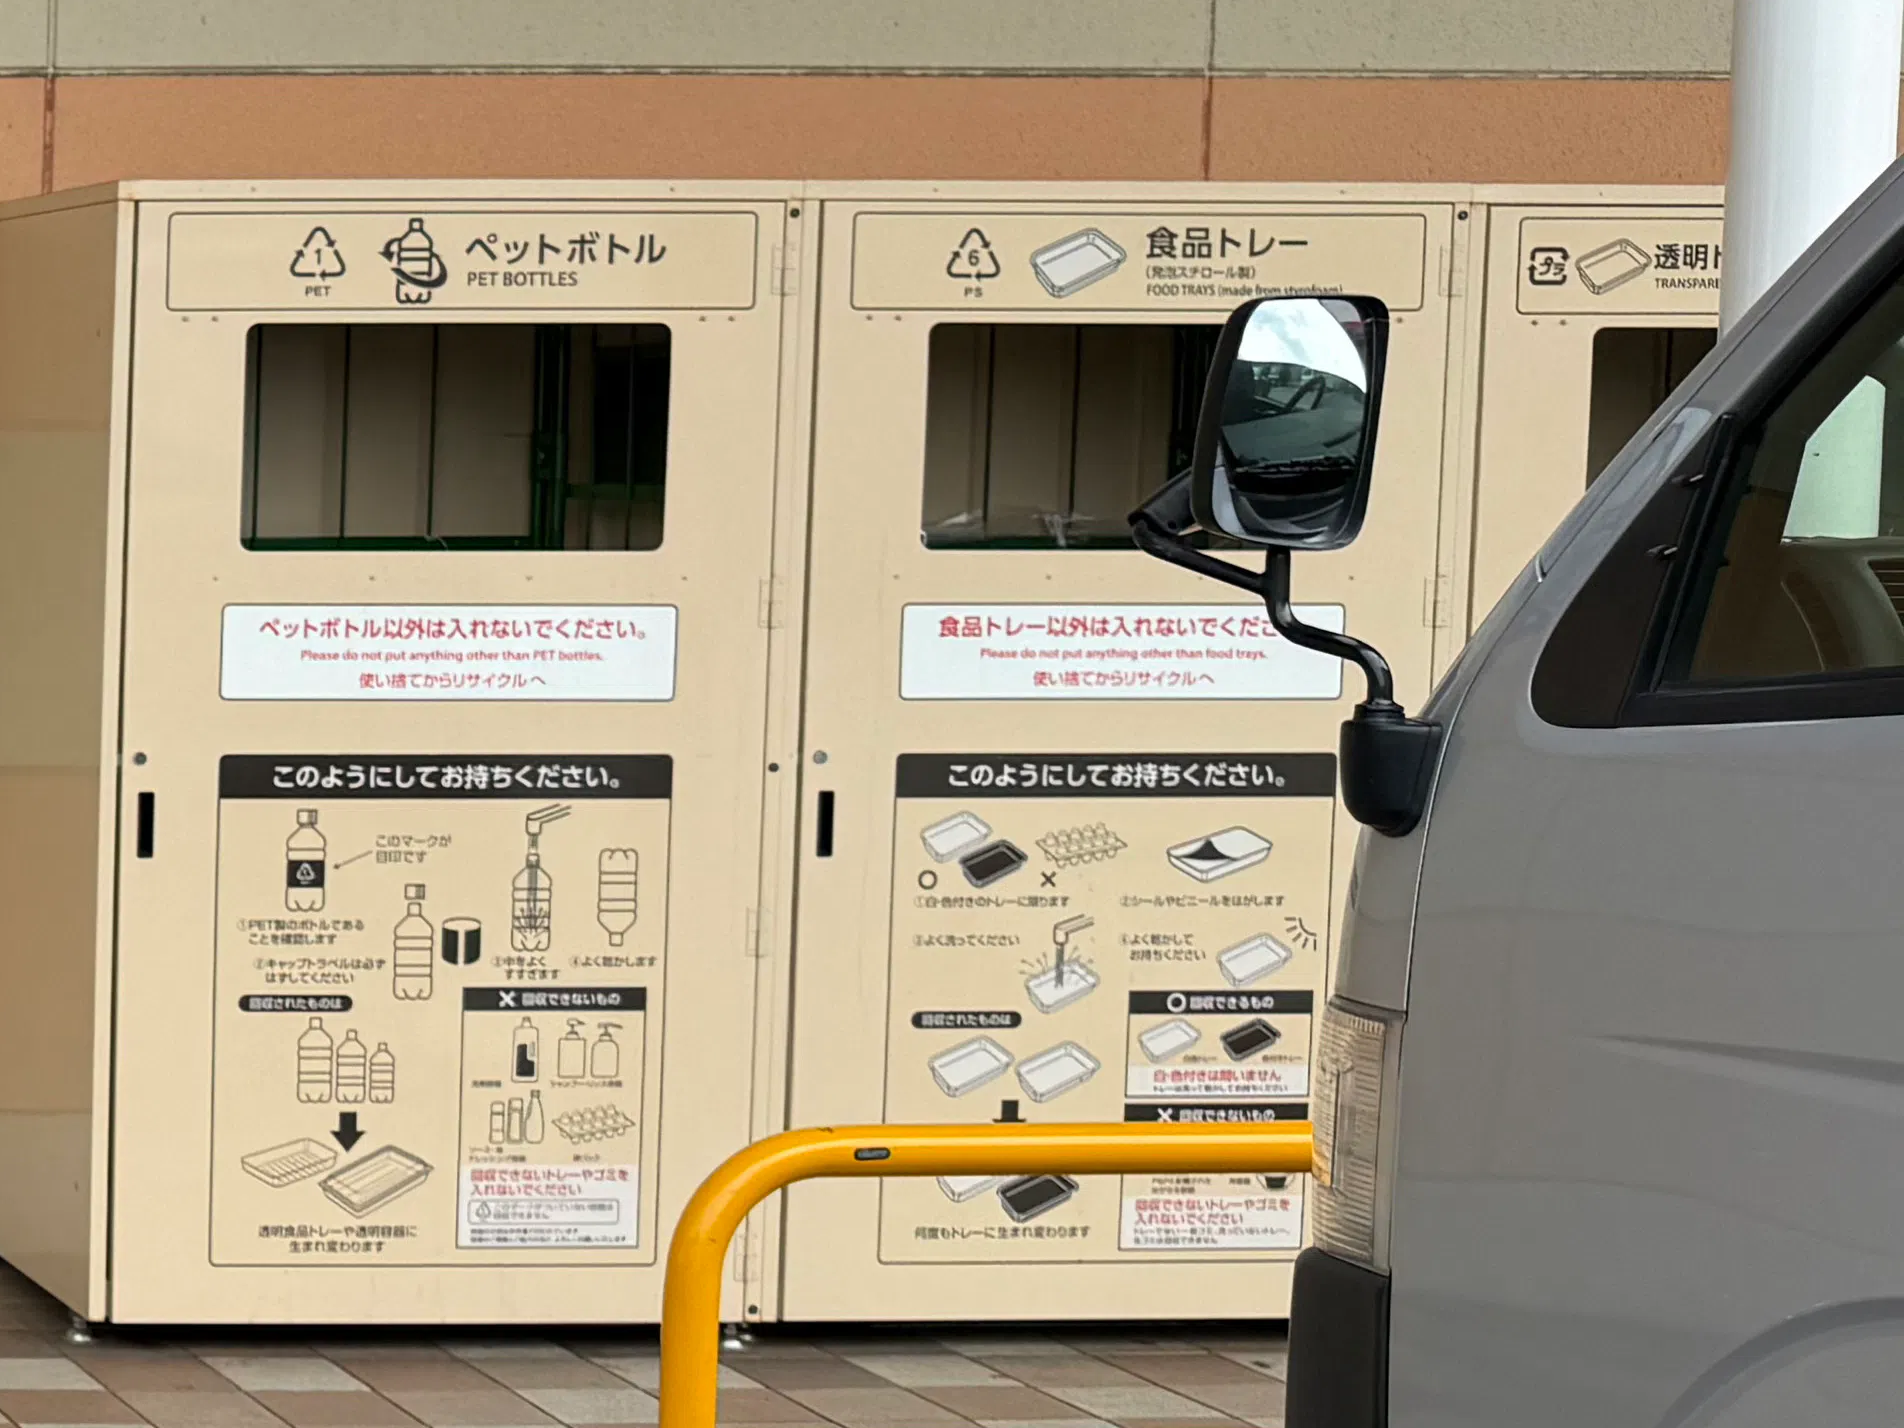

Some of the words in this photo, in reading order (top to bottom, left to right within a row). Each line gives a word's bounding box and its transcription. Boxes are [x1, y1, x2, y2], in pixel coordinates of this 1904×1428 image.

[464, 231, 667, 265] ペットボトル
[1145, 226, 1309, 260] 食品トレー
[968, 248, 980, 267] 6
[467, 272, 499, 288] PET
[503, 271, 578, 287] BOTTLES
[1655, 277, 1719, 289] TRANSPAR
[304, 285, 332, 297] PET
[964, 286, 983, 298] PS
[1146, 284, 1180, 297] FOOD
[1181, 283, 1216, 296] TRAYS
[259, 617, 646, 640] ペットボトル以外は入れないでください。
[301, 649, 339, 661] Please
[343, 648, 358, 661] do
[361, 650, 382, 661] not
[385, 650, 406, 663] put
[409, 649, 464, 663] anything
[466, 650, 498, 661] other
[502, 649, 530, 661] than
[533, 650, 556, 661] PET
[558, 649, 604, 661] bottles.
[980, 647, 1017, 659] Please
[1020, 646, 1036, 659] do
[1039, 648, 1060, 659] not
[1062, 648, 1082, 661] put
[1085, 647, 1138, 661] anything
[1141, 647, 1172, 659] other
[1175, 647, 1203, 659] than
[1205, 647, 1233, 659] food
[272, 763, 621, 790] このようにしてお持ちください。
[947, 762, 1286, 789] このようにしてお持ちください。
[375, 833, 452, 848] このマークが
